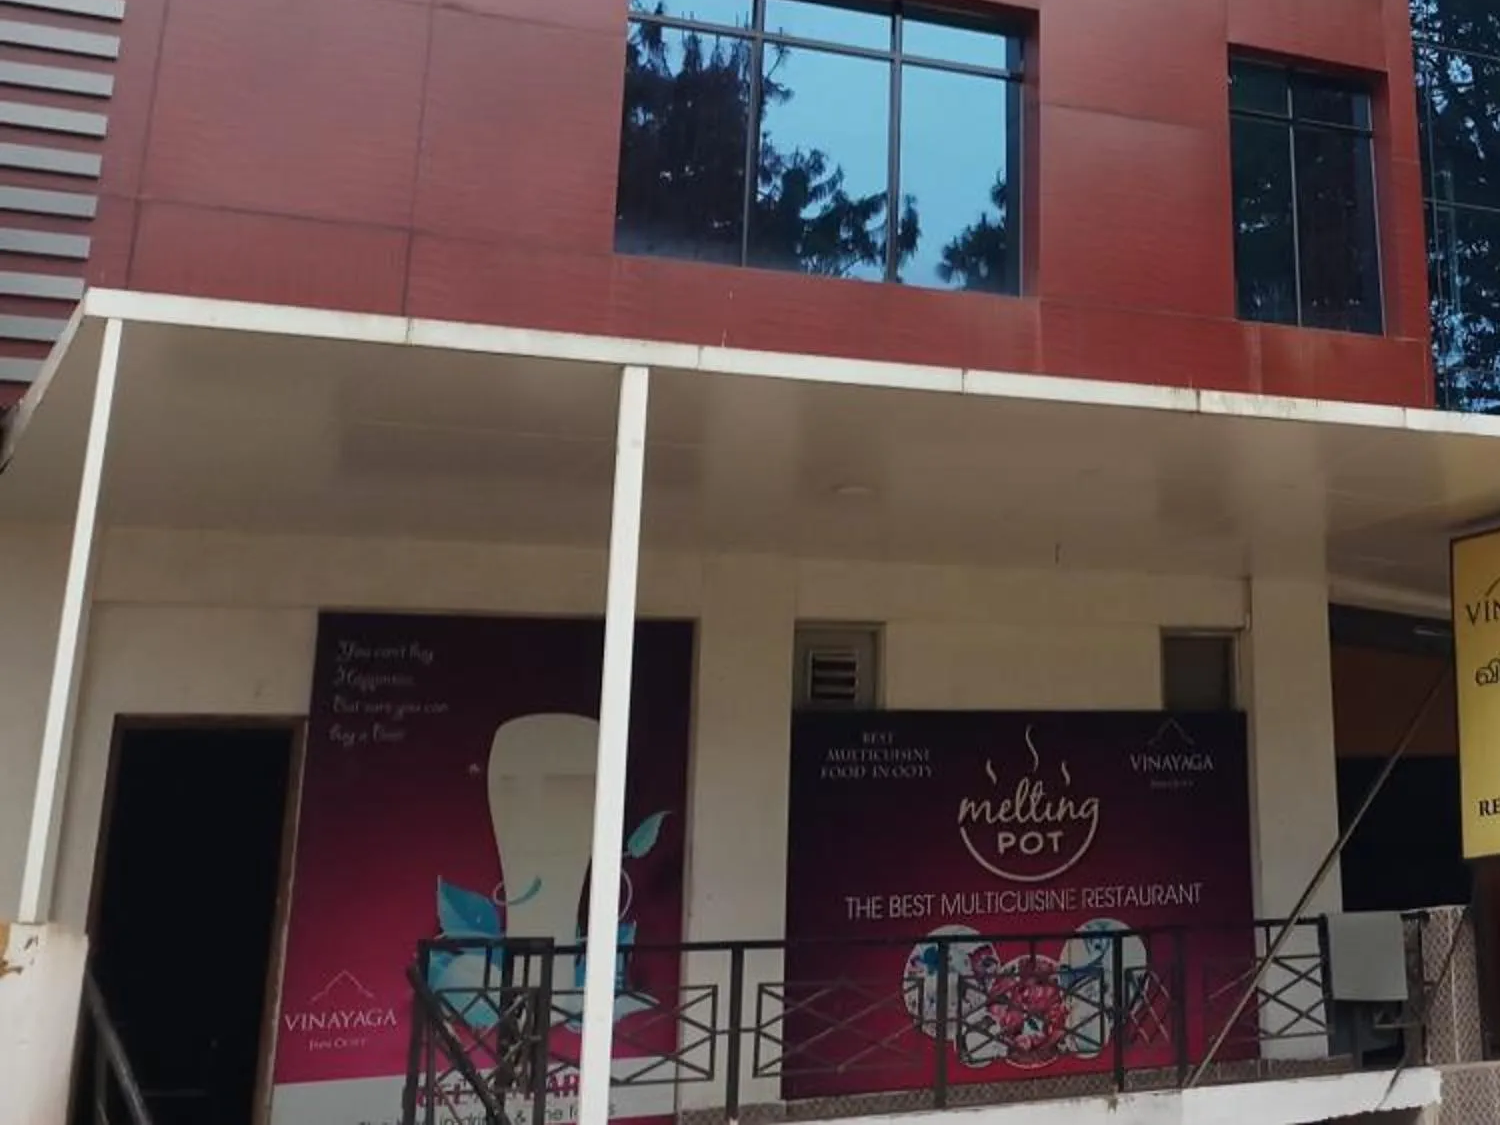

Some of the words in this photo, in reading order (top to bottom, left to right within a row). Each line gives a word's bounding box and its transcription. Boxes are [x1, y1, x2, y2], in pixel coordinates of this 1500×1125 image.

[1129, 753, 1215, 772] VINAYAGA
[958, 776, 1101, 826] melting
[998, 831, 1065, 856] POT
[845, 896, 884, 920] THE
[888, 893, 936, 918] BEST
[940, 887, 1077, 917] MULTICUISINE
[1082, 882, 1204, 910] RESTAURANT
[284, 1007, 398, 1032] VINAYAGA
